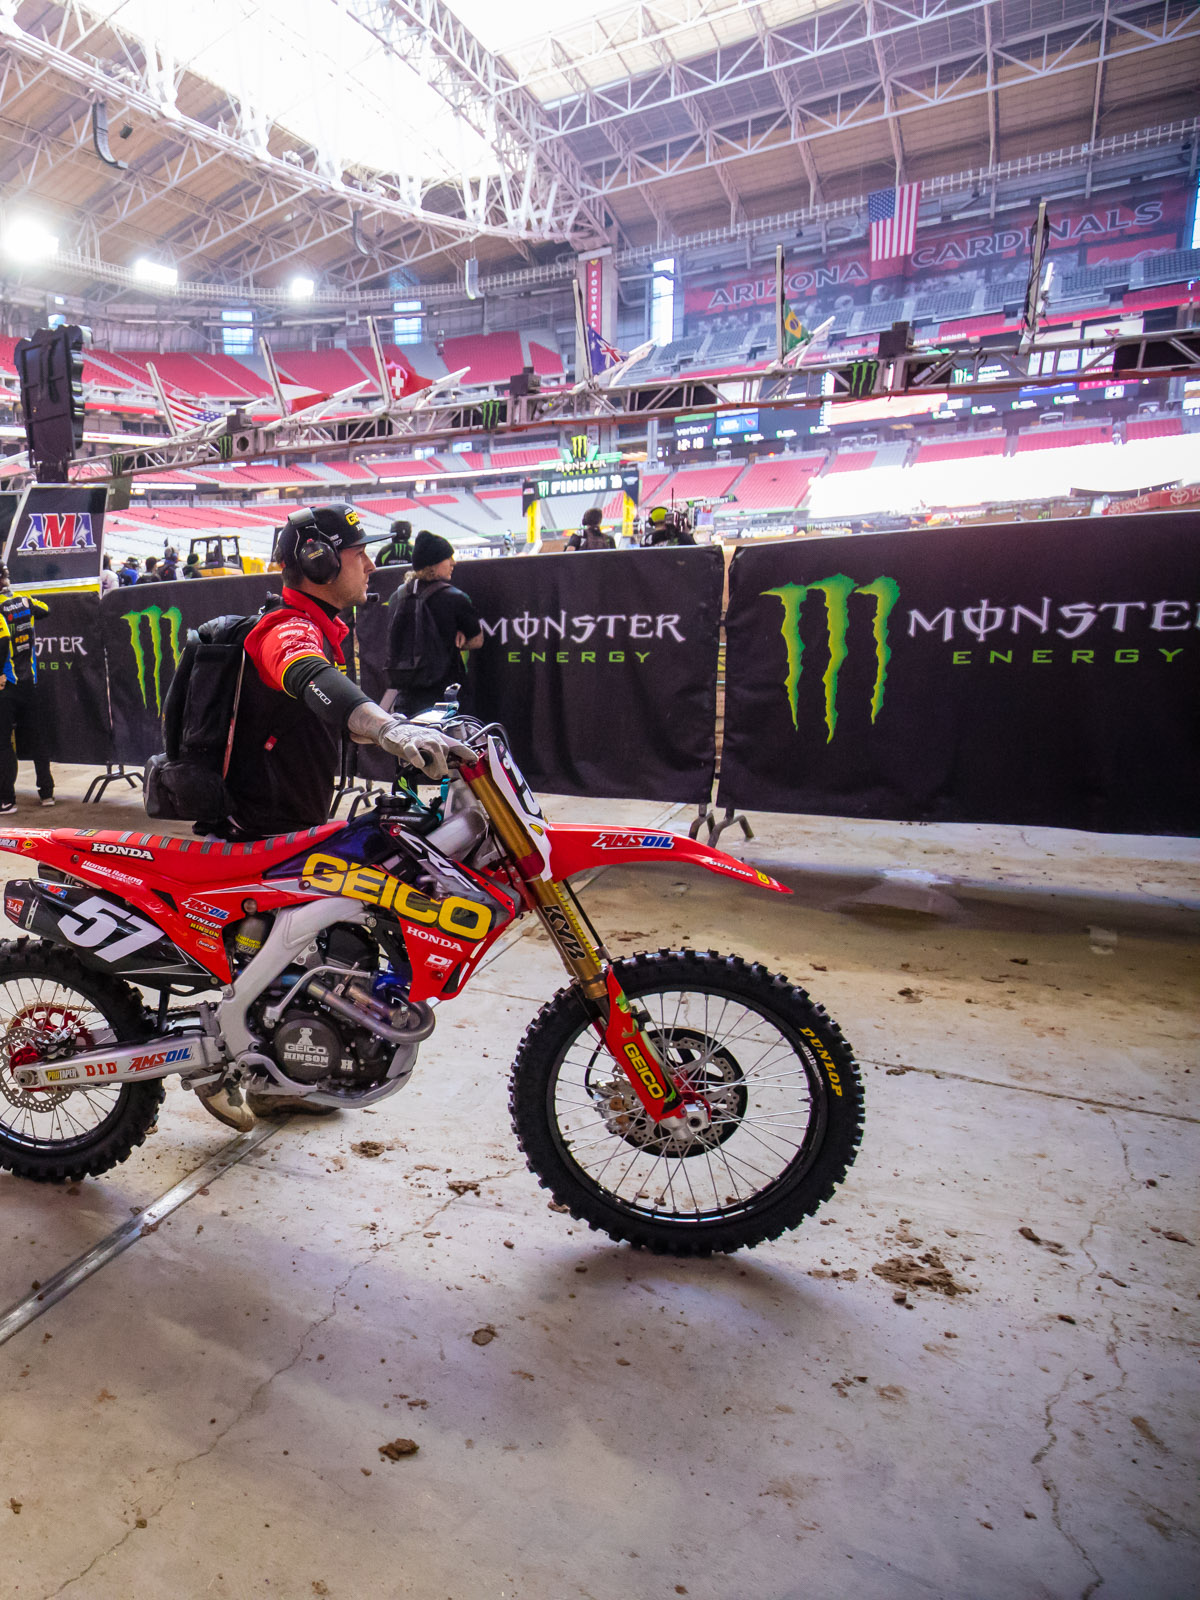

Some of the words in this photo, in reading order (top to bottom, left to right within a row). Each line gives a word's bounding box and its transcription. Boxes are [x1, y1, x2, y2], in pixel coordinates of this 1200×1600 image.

[708, 261, 868, 308] ARIZONA
[911, 201, 1164, 269] CARDINALS
[590, 270, 598, 328] FOOTBAL
[676, 425, 708, 437] verizon
[550, 476, 607, 495] FINISH
[16, 512, 96, 551] AMA
[478, 610, 686, 646] MONSTER
[907, 596, 1200, 642] MONSTE
[39, 661, 73, 670] RGY
[507, 651, 650, 663] ENERGY
[952, 648, 1184, 665] ENERGY
[92, 843, 153, 861] HONDA
[591, 832, 675, 850] AMSOIL
[82, 860, 112, 875] Honda
[111, 868, 144, 886] Racing
[708, 860, 753, 877] DUNLOP
[302, 852, 492, 940] GEICO
[57, 896, 166, 963] 57
[185, 912, 223, 930] DUNLOP
[189, 922, 220, 939] HINSON
[543, 904, 586, 960] KYB
[406, 926, 464, 953] HONDA
[283, 1051, 329, 1064] HINSON
[285, 1043, 327, 1055] GEICO
[125, 1047, 193, 1074] AMSOIL
[340, 1059, 354, 1071] H
[625, 1042, 666, 1101] GEICO
[799, 1026, 844, 1098] DUNLOP
